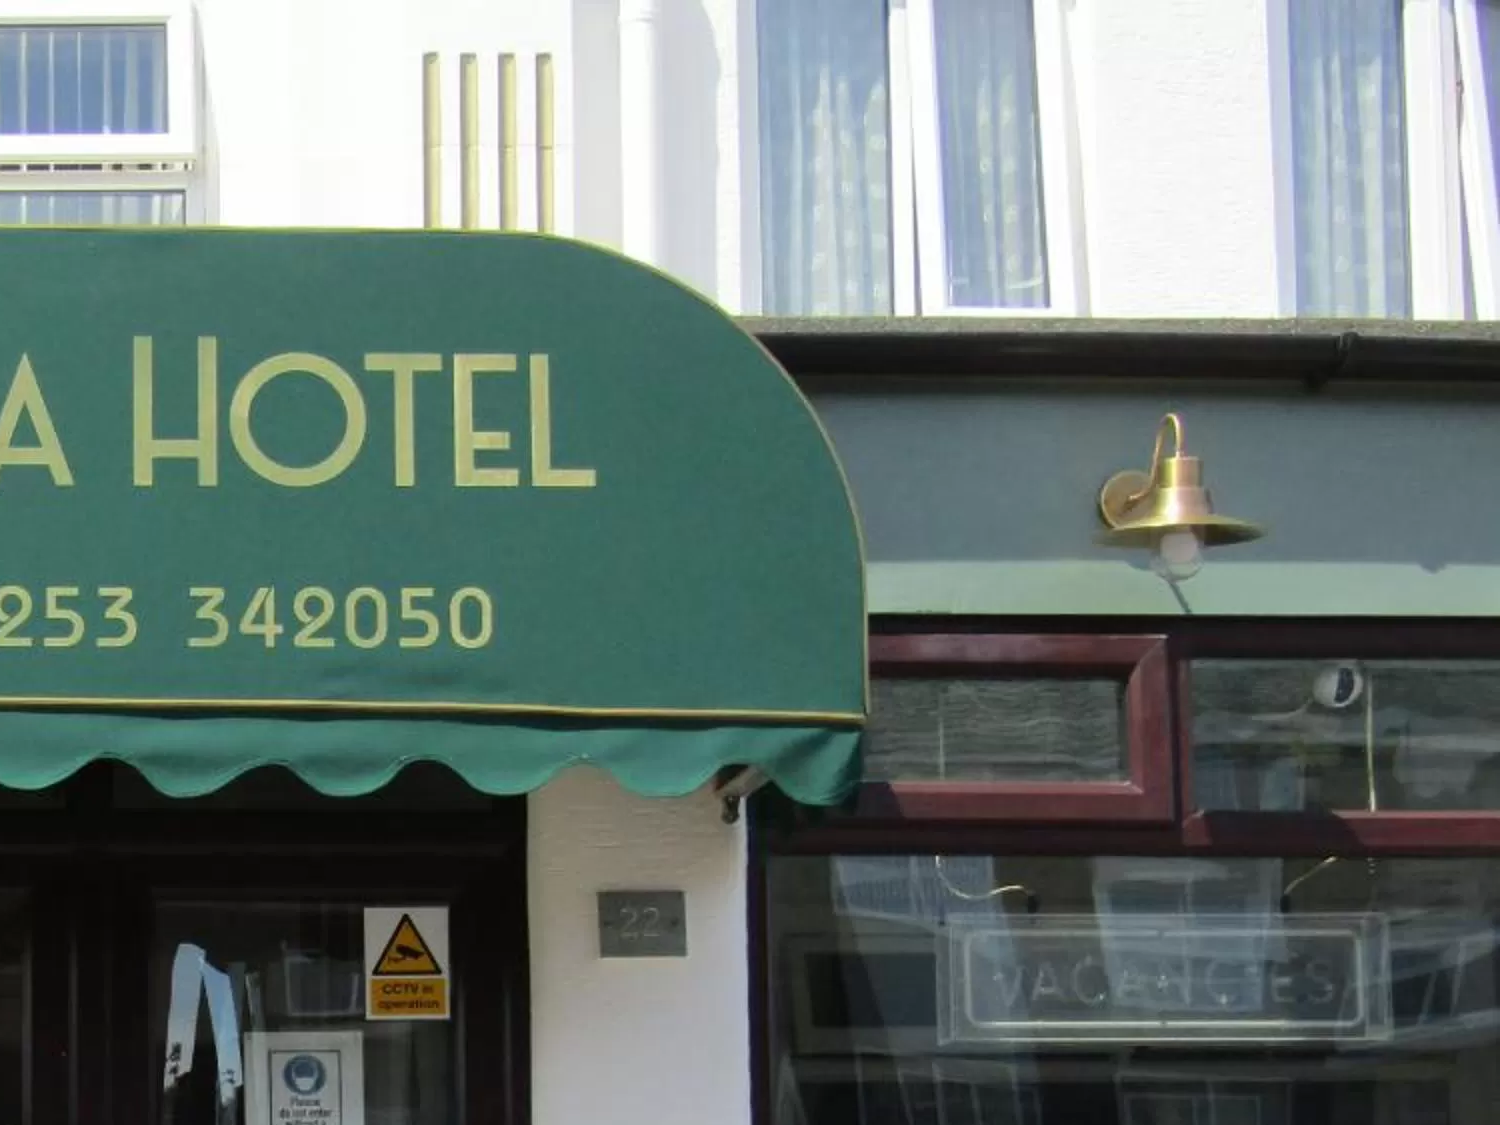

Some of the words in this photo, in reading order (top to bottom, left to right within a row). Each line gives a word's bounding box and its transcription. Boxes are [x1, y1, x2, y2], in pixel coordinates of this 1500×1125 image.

[131, 334, 598, 488] HOTEL
[186, 584, 495, 650] 342050
[619, 907, 661, 938] 22
[382, 983, 419, 995] CCTV
[991, 957, 1336, 1009] VACANCES
